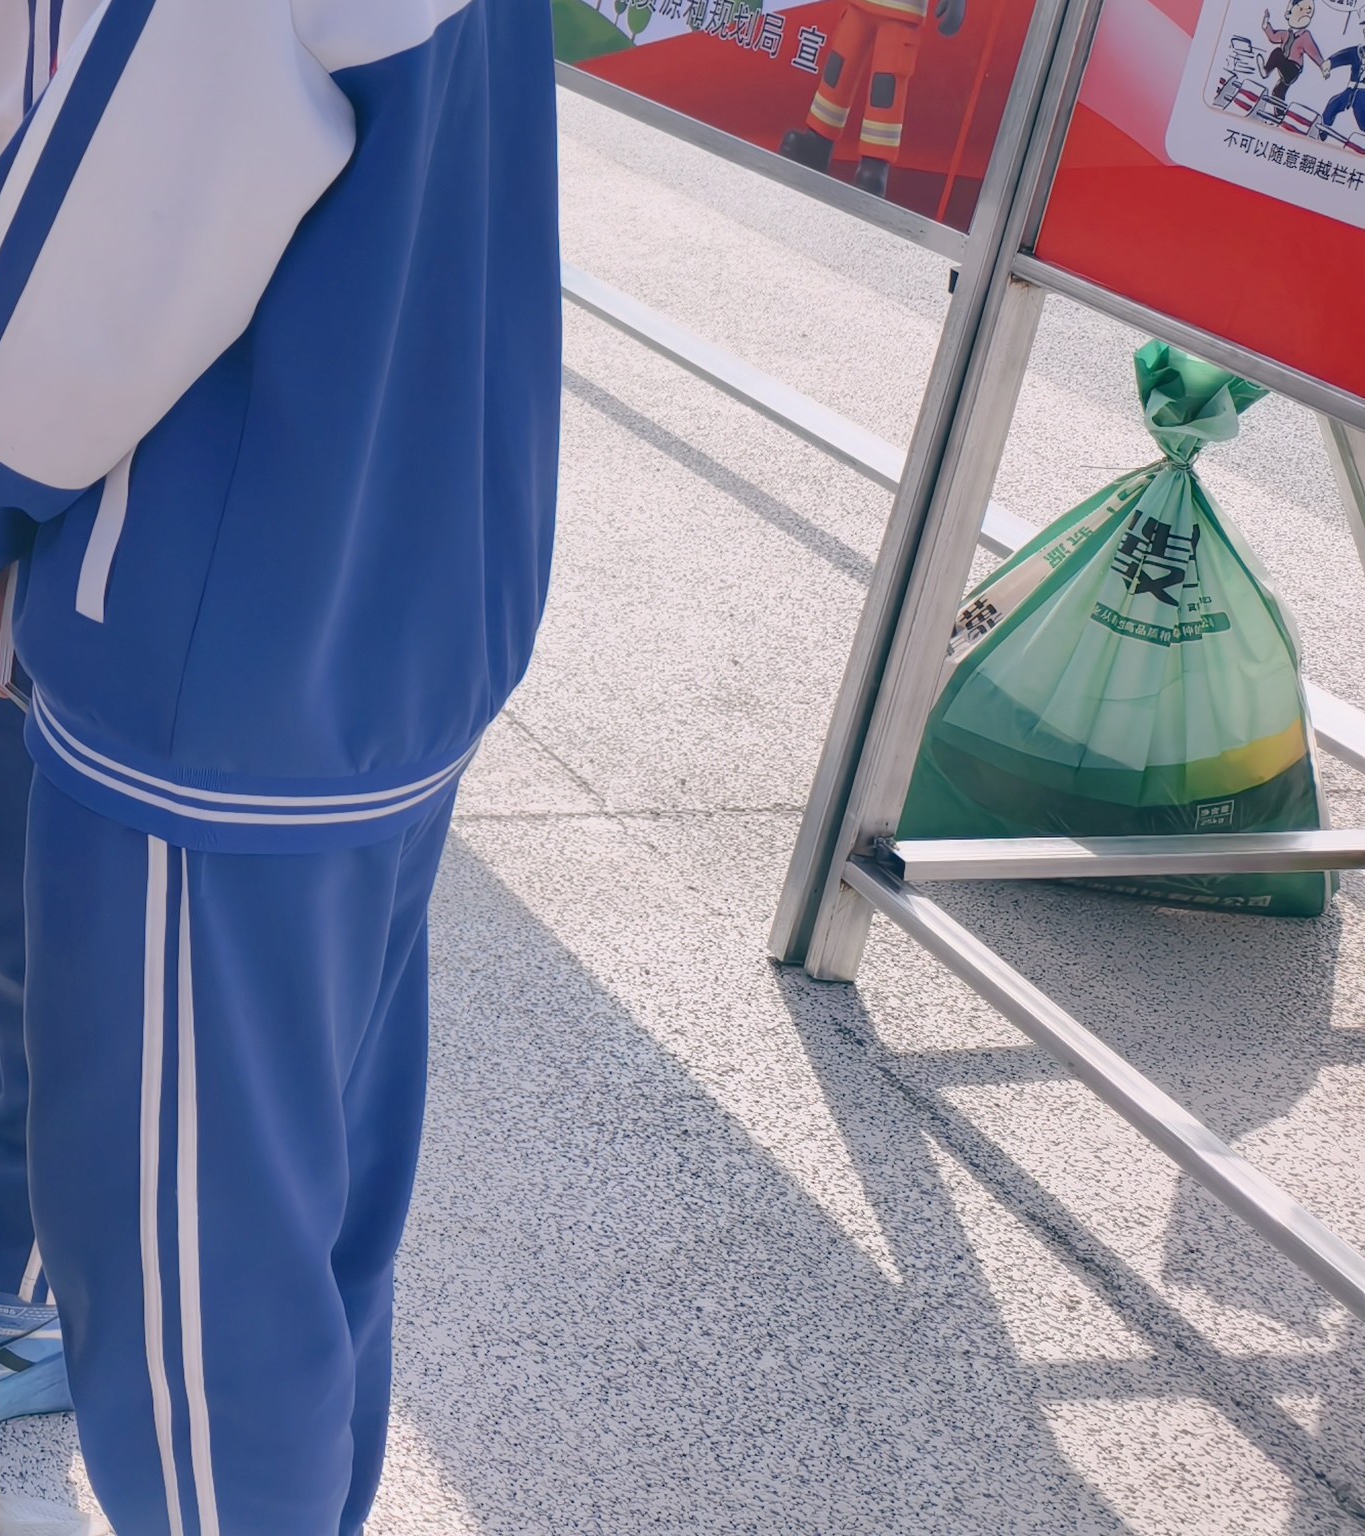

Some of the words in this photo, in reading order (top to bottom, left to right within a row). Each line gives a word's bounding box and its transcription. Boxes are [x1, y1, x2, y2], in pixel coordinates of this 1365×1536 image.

[790, 24, 827, 75] 宣
[1223, 128, 1364, 192] 不可以随意翻越栏杆
